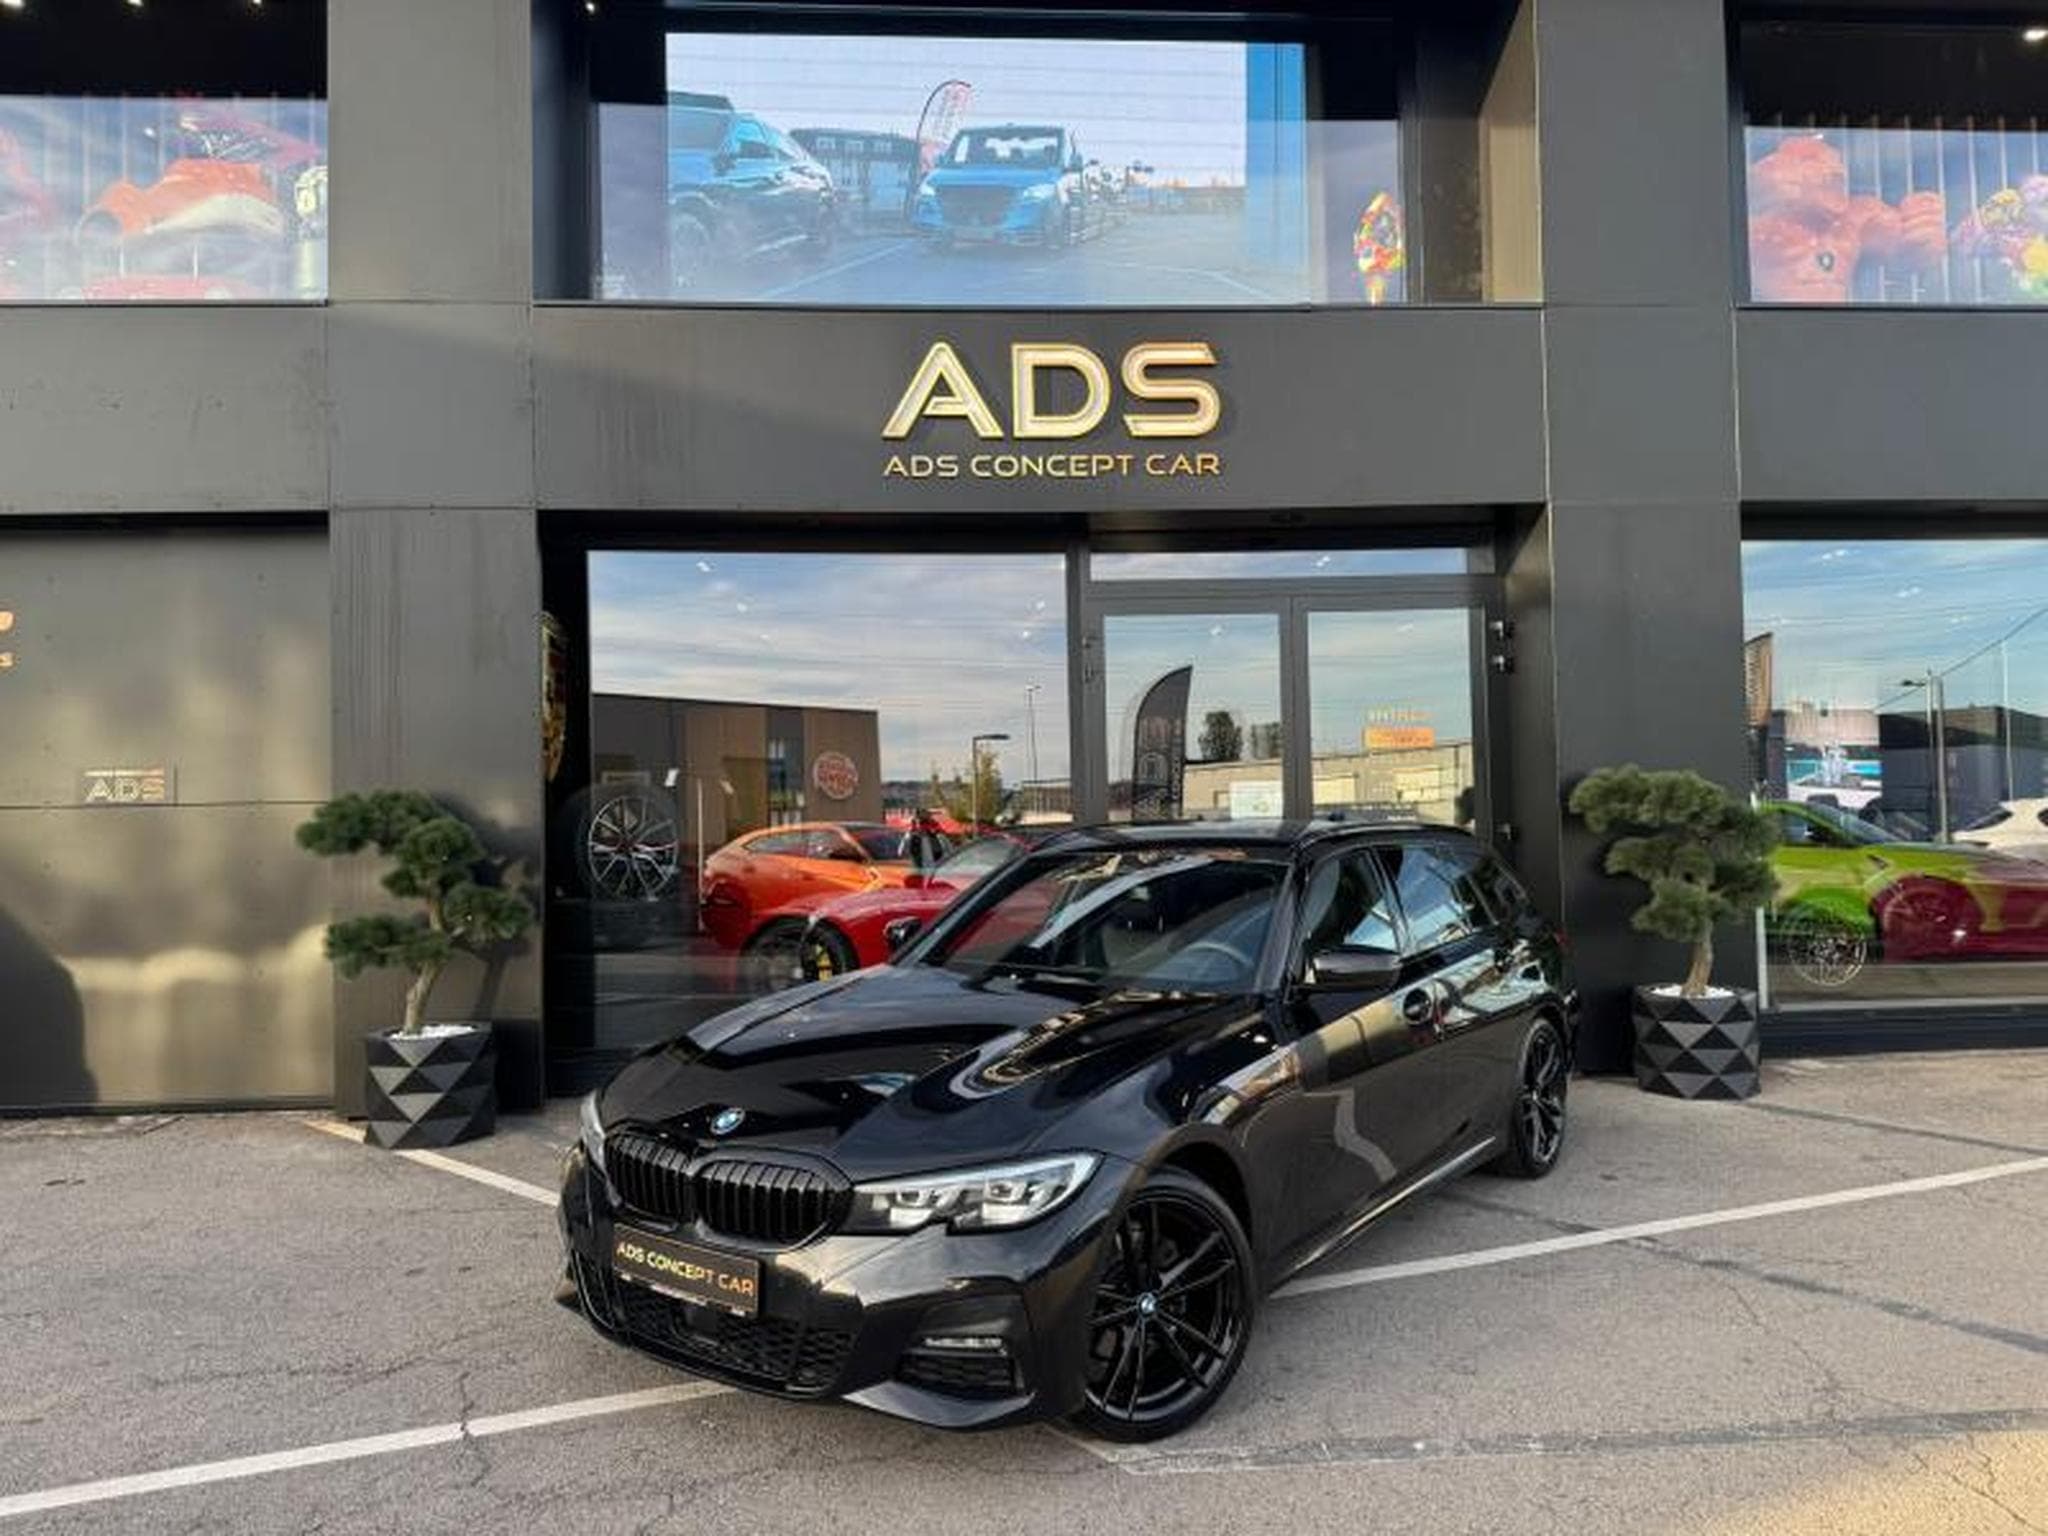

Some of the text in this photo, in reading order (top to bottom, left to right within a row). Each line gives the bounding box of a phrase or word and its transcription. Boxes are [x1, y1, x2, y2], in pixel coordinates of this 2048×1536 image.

[882, 341, 1220, 438] ADS
[883, 453, 1220, 477] ADS CONCEPT CAR
[84, 776, 165, 803] ADS
[616, 1241, 754, 1297] ADS CONCEPT CAR
